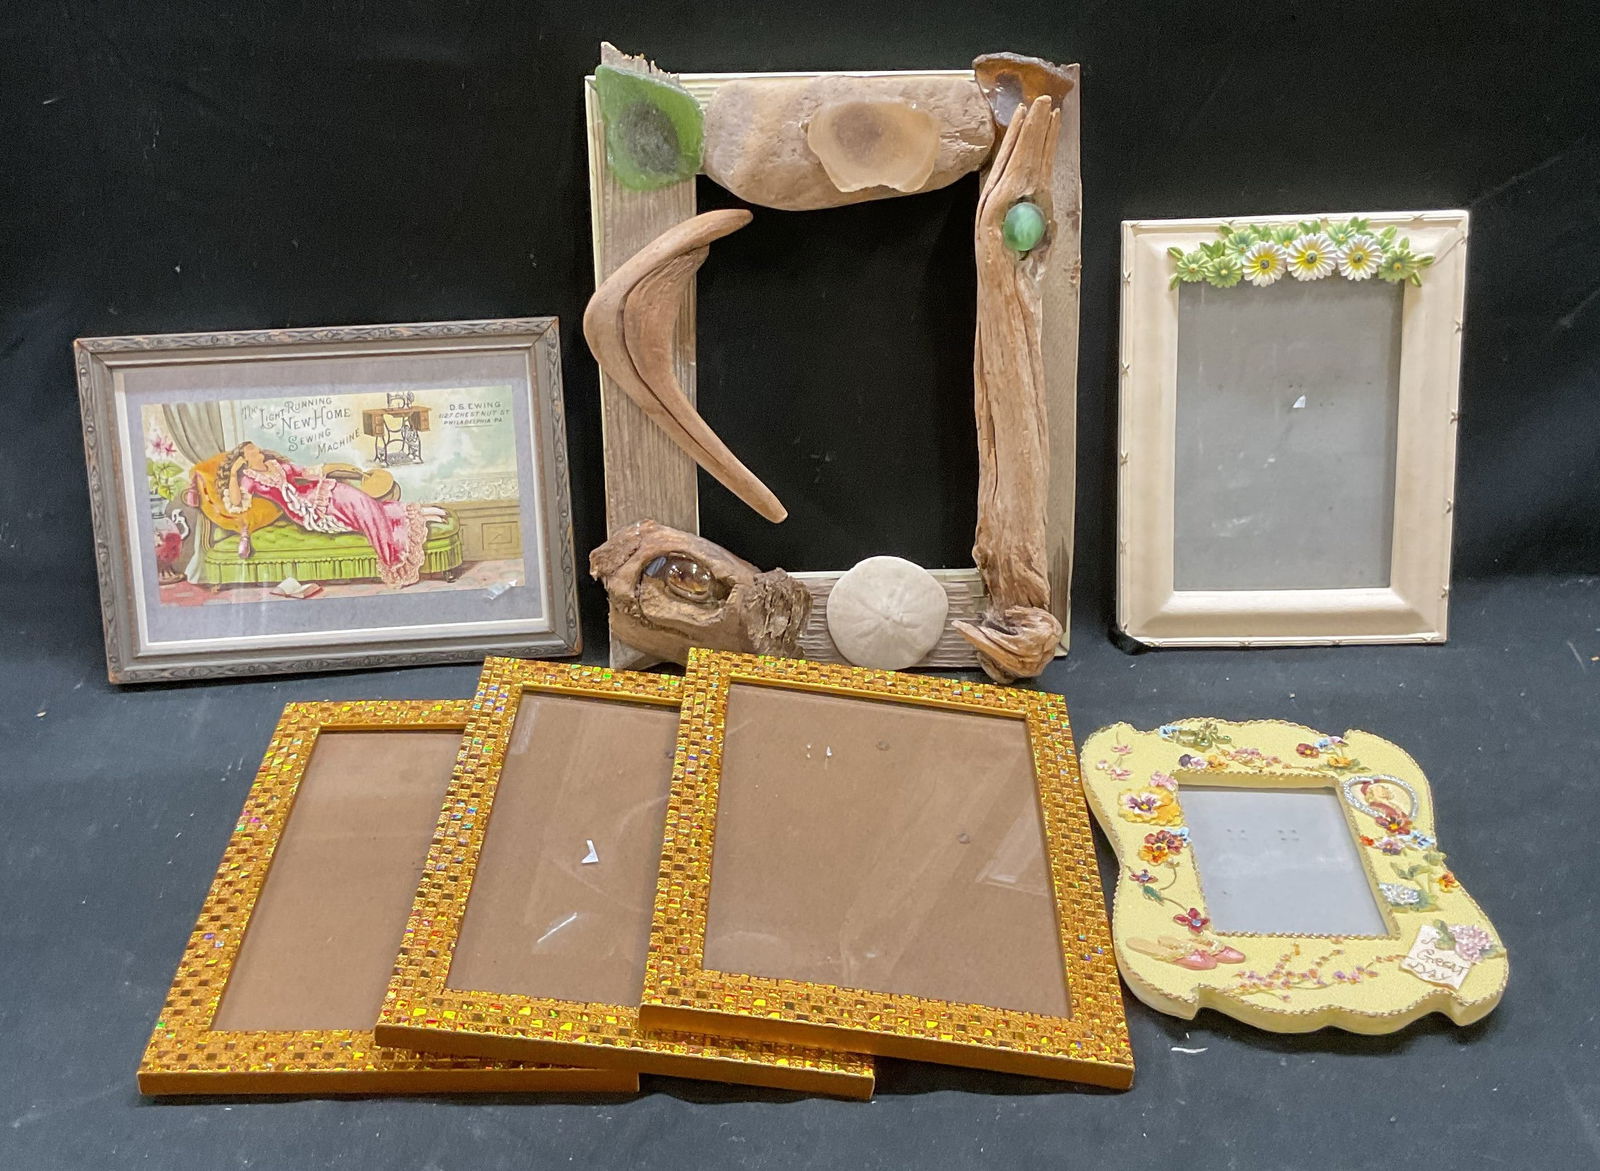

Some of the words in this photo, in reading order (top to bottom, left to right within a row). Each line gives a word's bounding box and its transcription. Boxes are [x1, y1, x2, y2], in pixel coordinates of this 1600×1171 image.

[260, 408, 285, 429] LIGHT
[284, 397, 333, 413] RUNNING
[454, 409, 498, 419] CHESTNUT
[468, 401, 501, 410] EWING
[276, 417, 311, 438] NEW
[312, 406, 352, 430] HOME
[288, 428, 331, 452] SEWING
[315, 428, 361, 459] MACHINE
